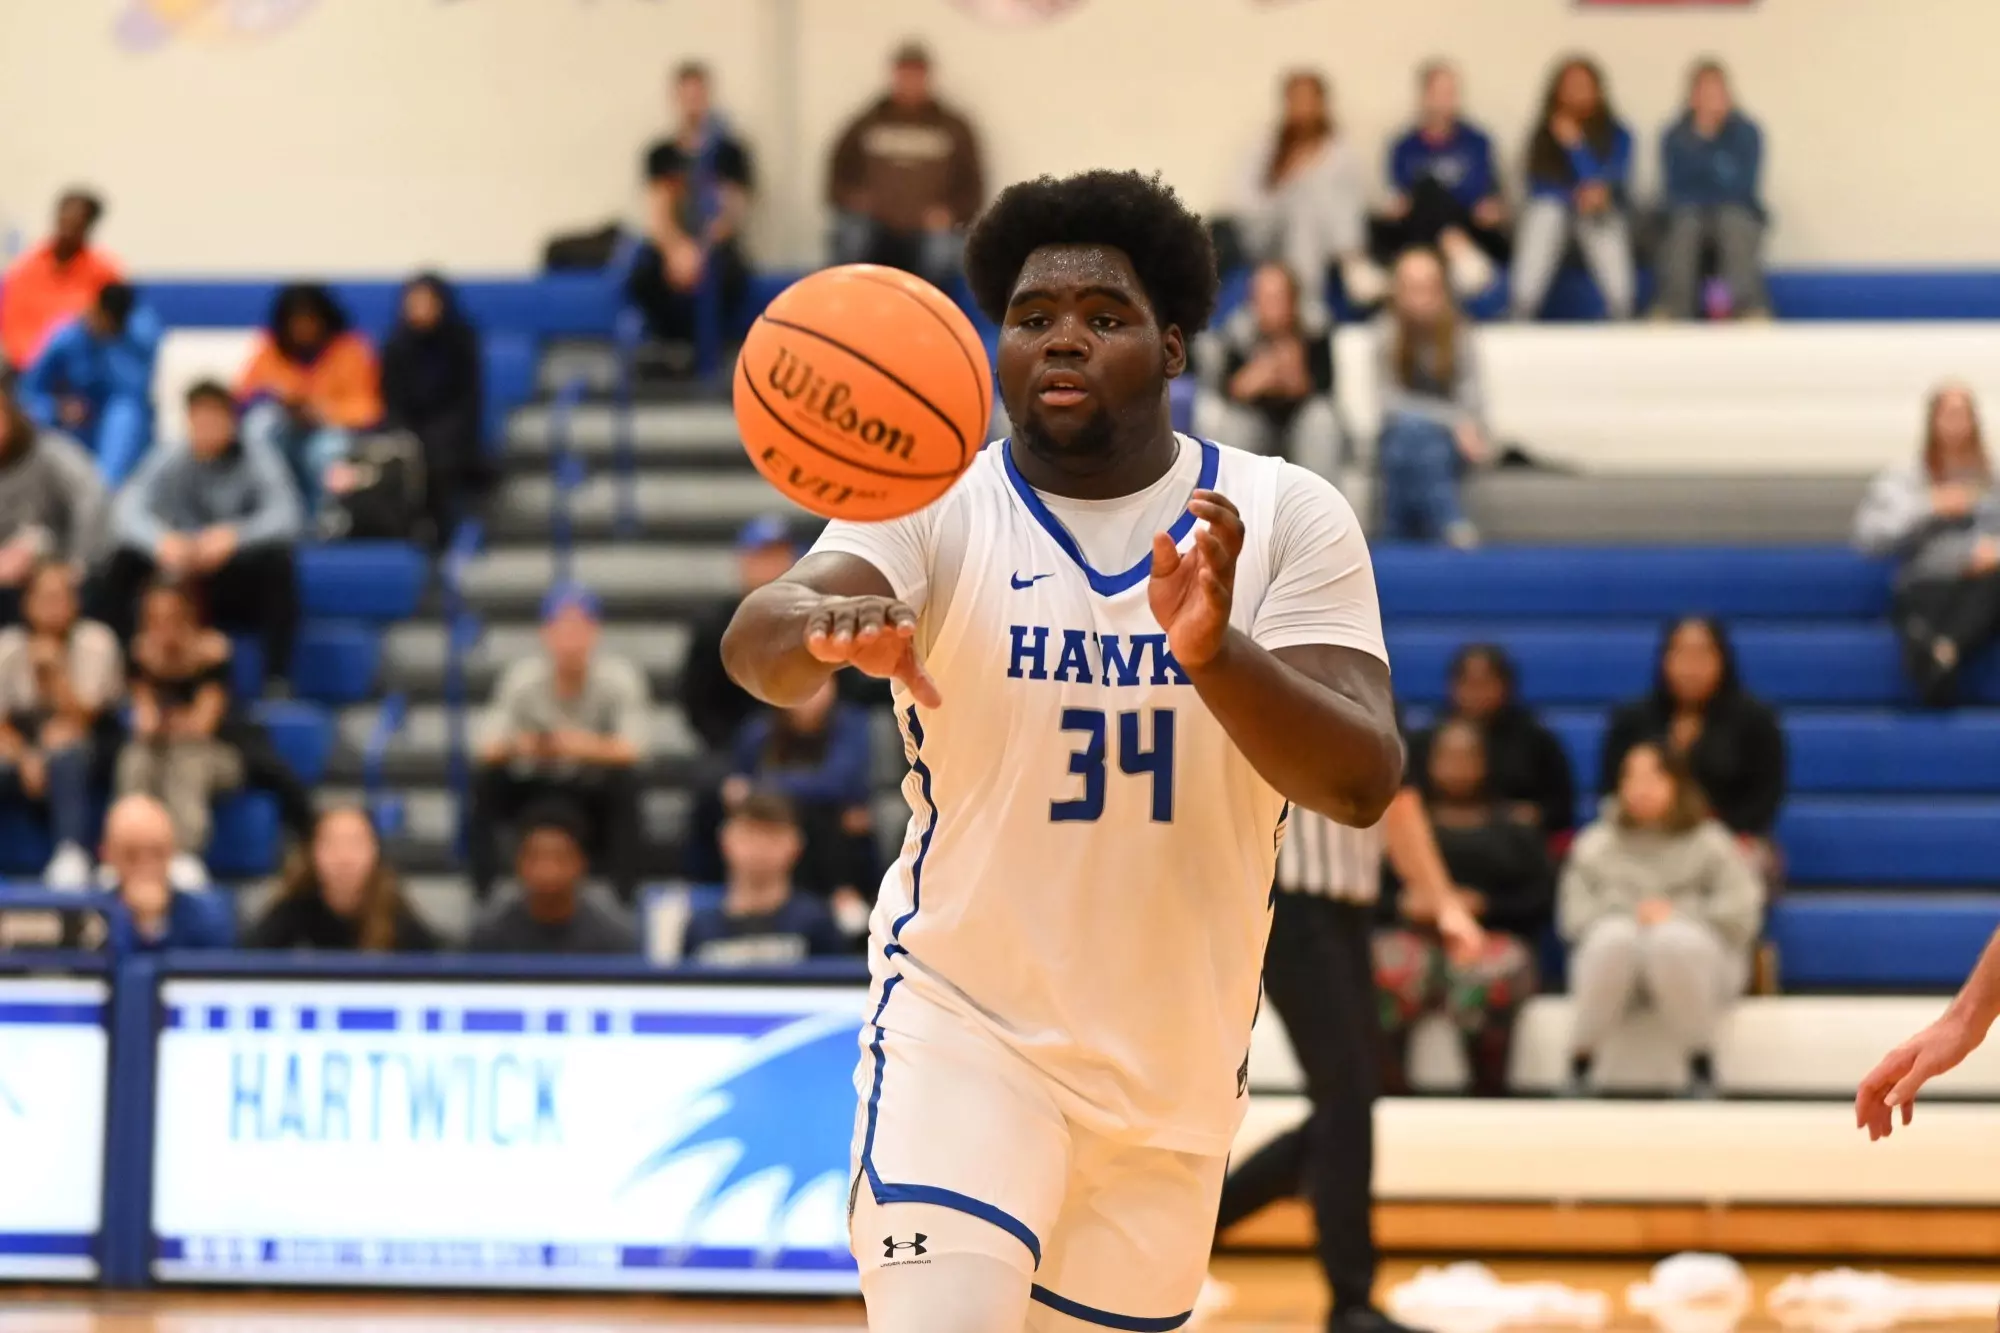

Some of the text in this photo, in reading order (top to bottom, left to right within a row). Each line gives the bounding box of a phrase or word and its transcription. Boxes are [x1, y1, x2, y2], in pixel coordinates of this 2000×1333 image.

[769, 346, 916, 460] Wilson
[1048, 707, 1176, 823] 34
[230, 1050, 565, 1146] HARTWICK
